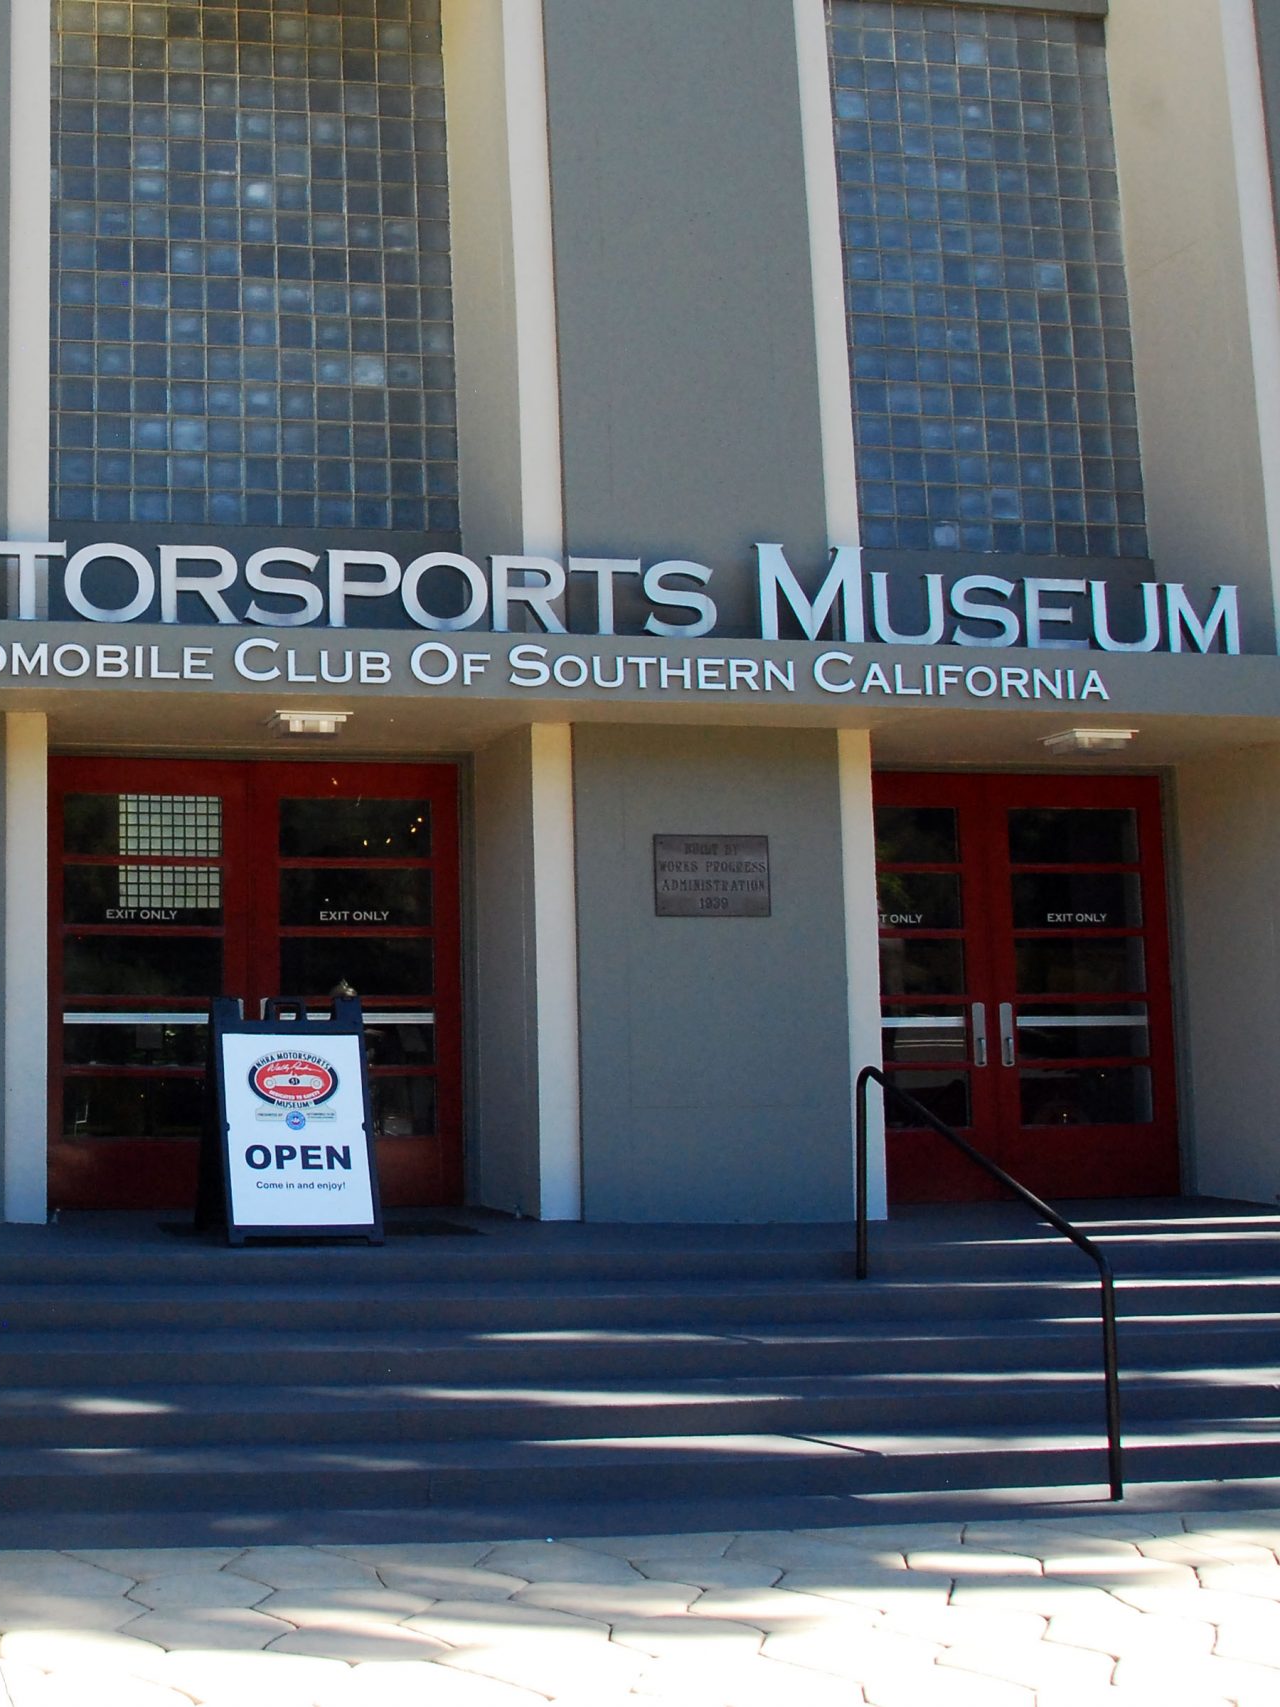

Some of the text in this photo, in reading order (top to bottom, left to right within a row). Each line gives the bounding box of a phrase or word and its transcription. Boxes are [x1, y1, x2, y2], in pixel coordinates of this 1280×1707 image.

[660, 861, 766, 873] WORKS PROGRESS
[662, 879, 765, 892] ADMINISTRATION
[699, 898, 729, 910] 1939
[106, 909, 178, 919] EXIT ONLY
[320, 911, 390, 921] EXIT ONLY
[889, 914, 923, 924] ONLY
[1047, 913, 1108, 922] EXIT ONLY
[256, 1052, 329, 1069] NHRA MOTORSPORTS
[245, 1144, 352, 1170] OPEN
[256, 1181, 283, 1189] Come
[286, 1181, 295, 1189] in
[317, 1182, 346, 1191] enjoy!
